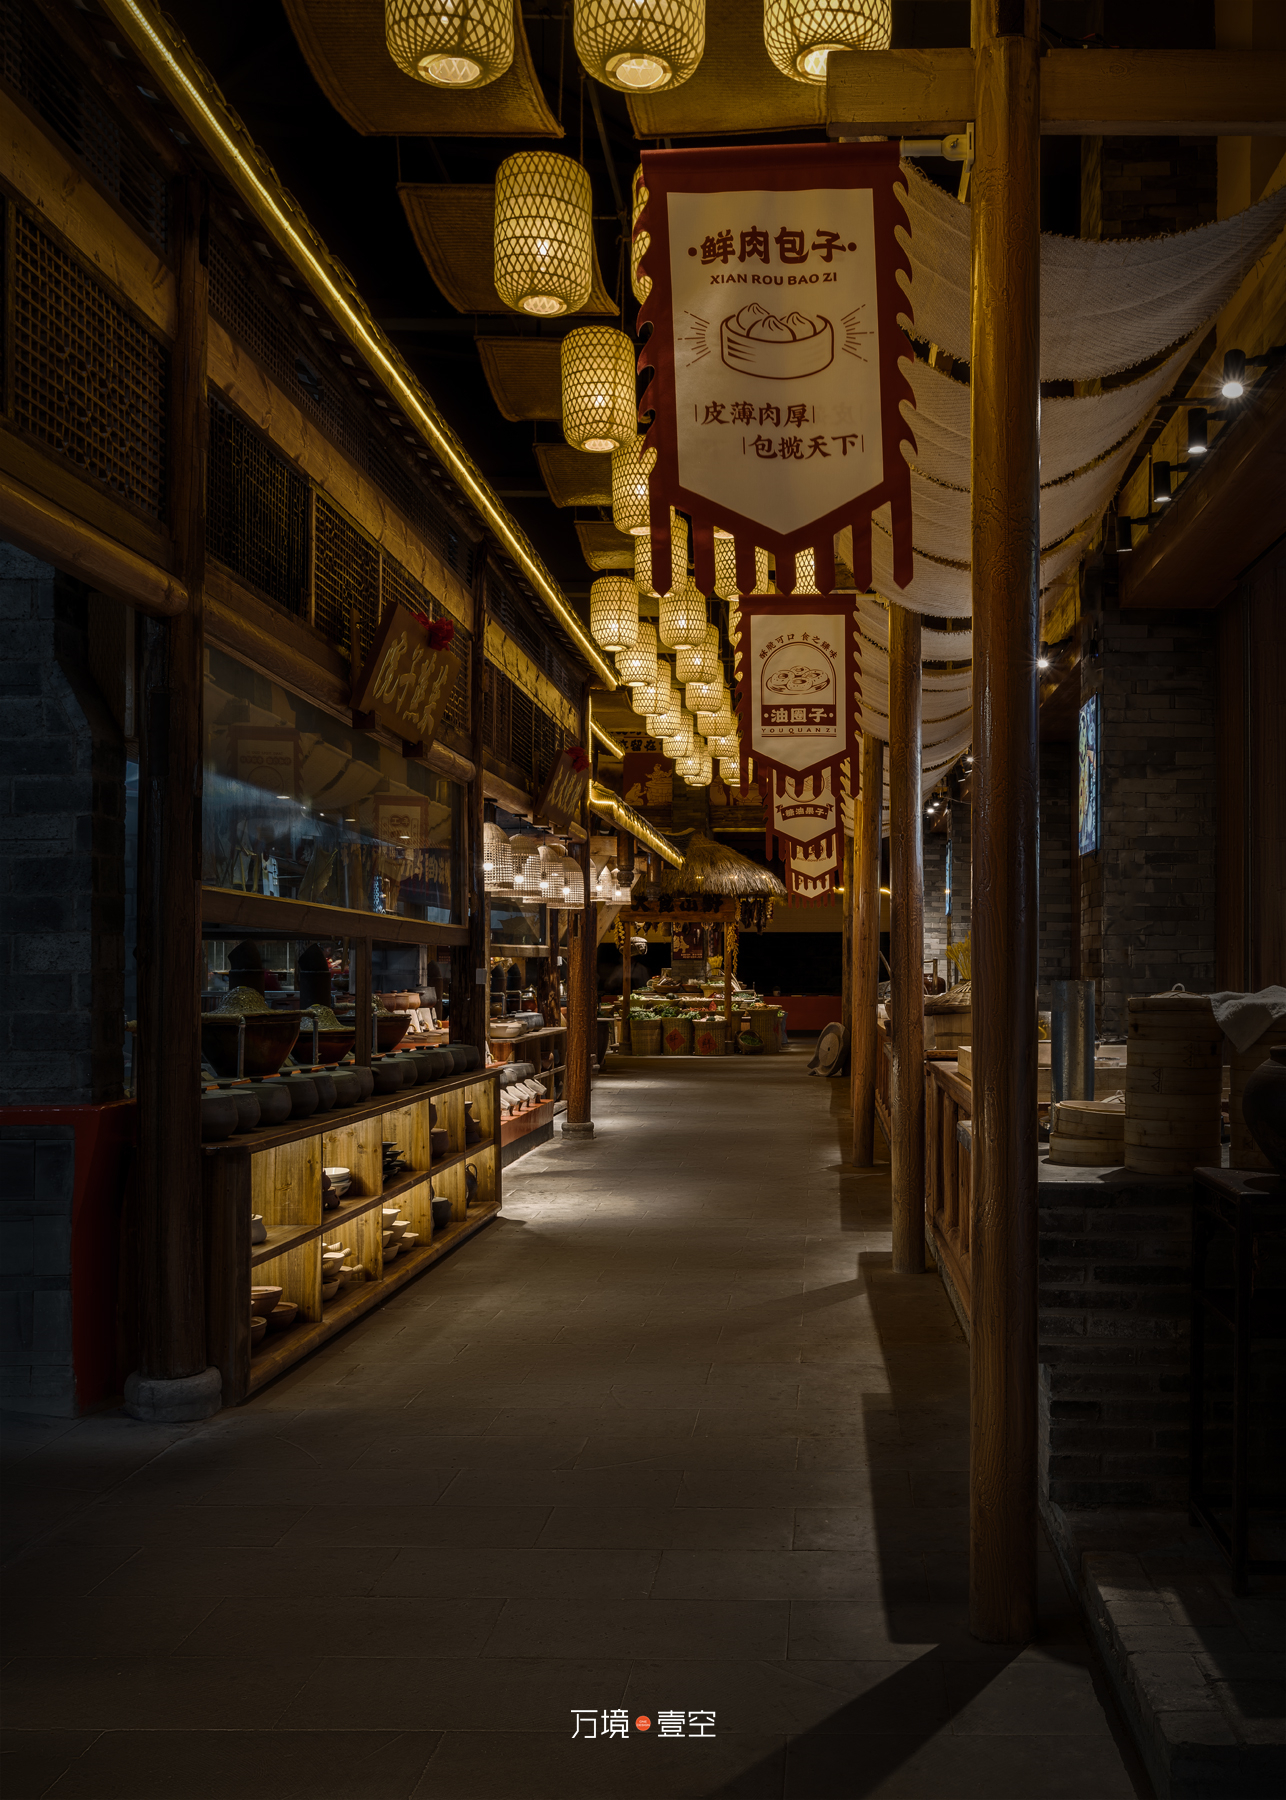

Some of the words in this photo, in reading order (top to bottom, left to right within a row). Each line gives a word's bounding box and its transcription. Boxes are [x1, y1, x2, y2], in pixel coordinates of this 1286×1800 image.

[700, 226, 847, 265] 鲜肉包子
[710, 273, 748, 285] XIAN
[752, 273, 783, 286] ROU
[788, 273, 819, 285] BAO
[823, 272, 838, 283] ZI
[701, 400, 810, 428] 皮薄肉厚
[748, 433, 859, 460] 包揽天下
[770, 707, 828, 723] 油圈子
